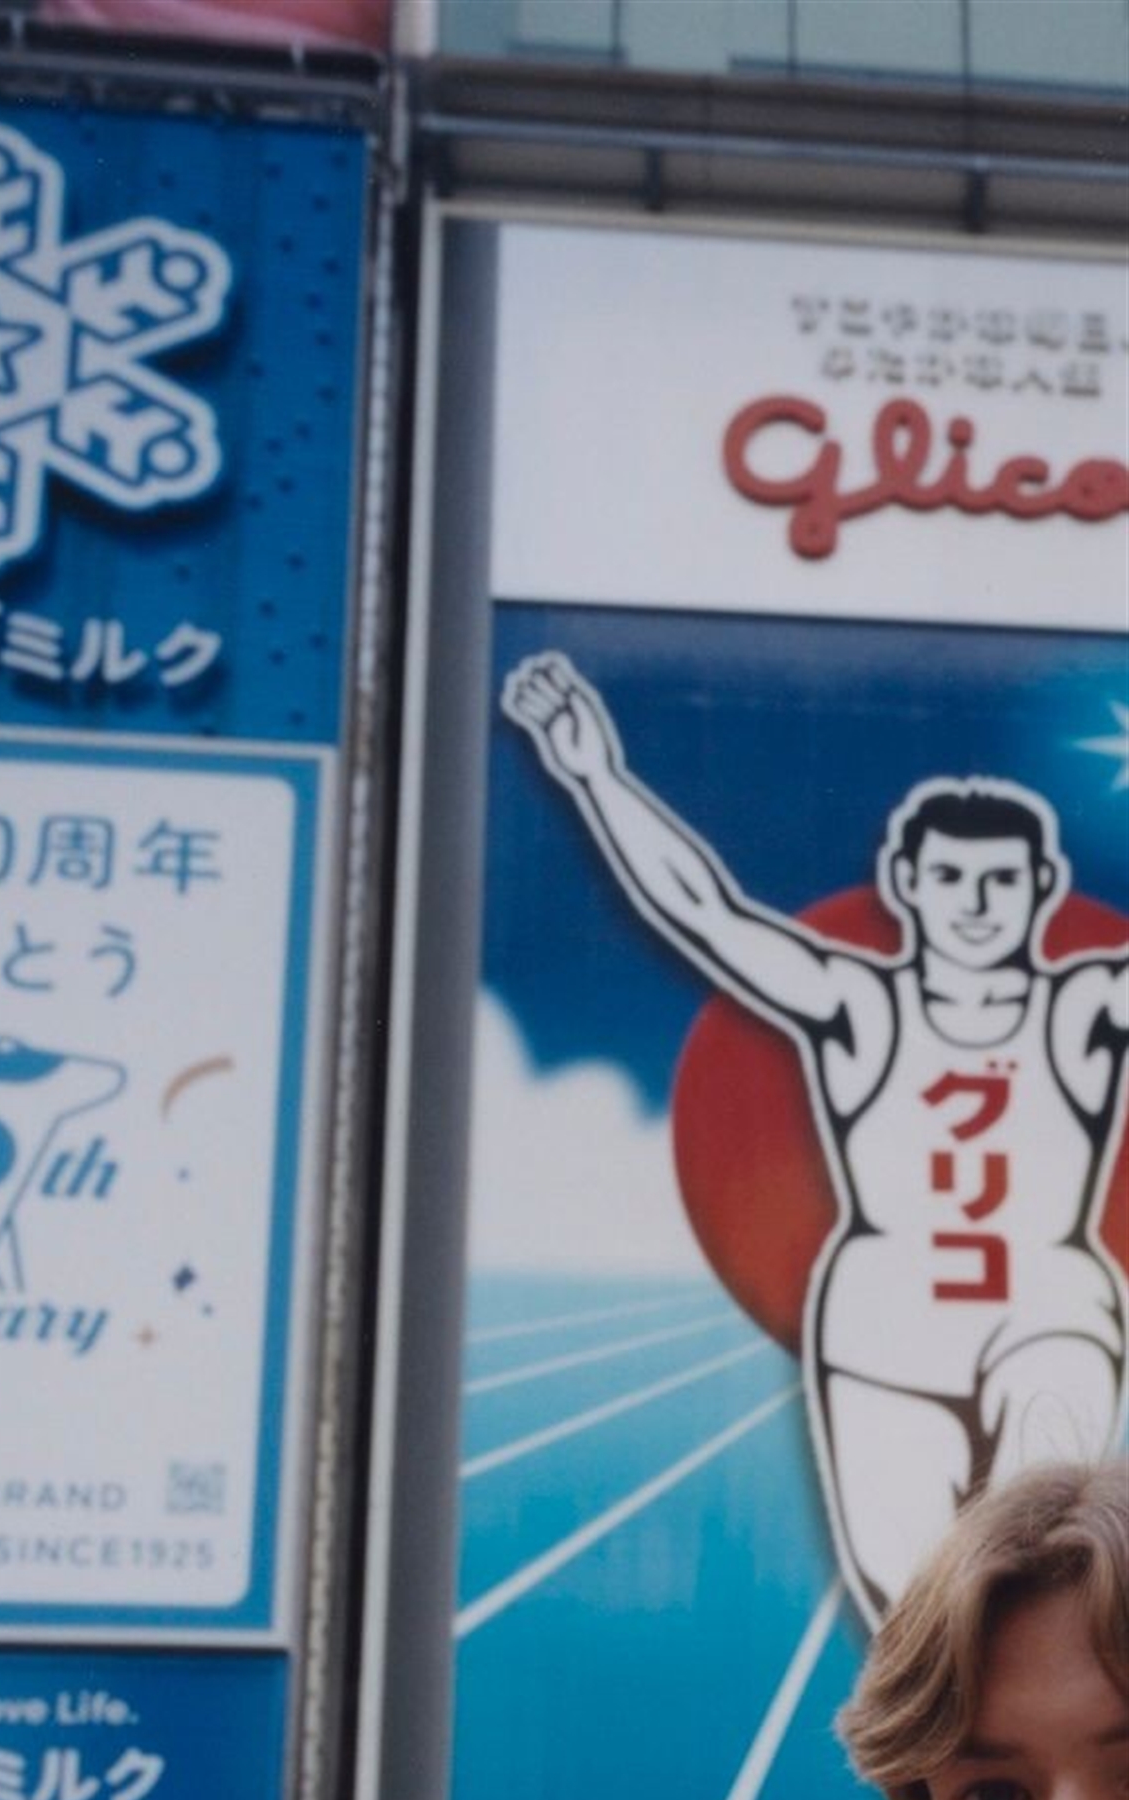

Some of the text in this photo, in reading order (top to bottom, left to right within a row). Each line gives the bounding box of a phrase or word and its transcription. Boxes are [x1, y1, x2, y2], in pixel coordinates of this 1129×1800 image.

[921, 1059, 1019, 1302] グリコ
[55, 1691, 139, 1725] Life.
